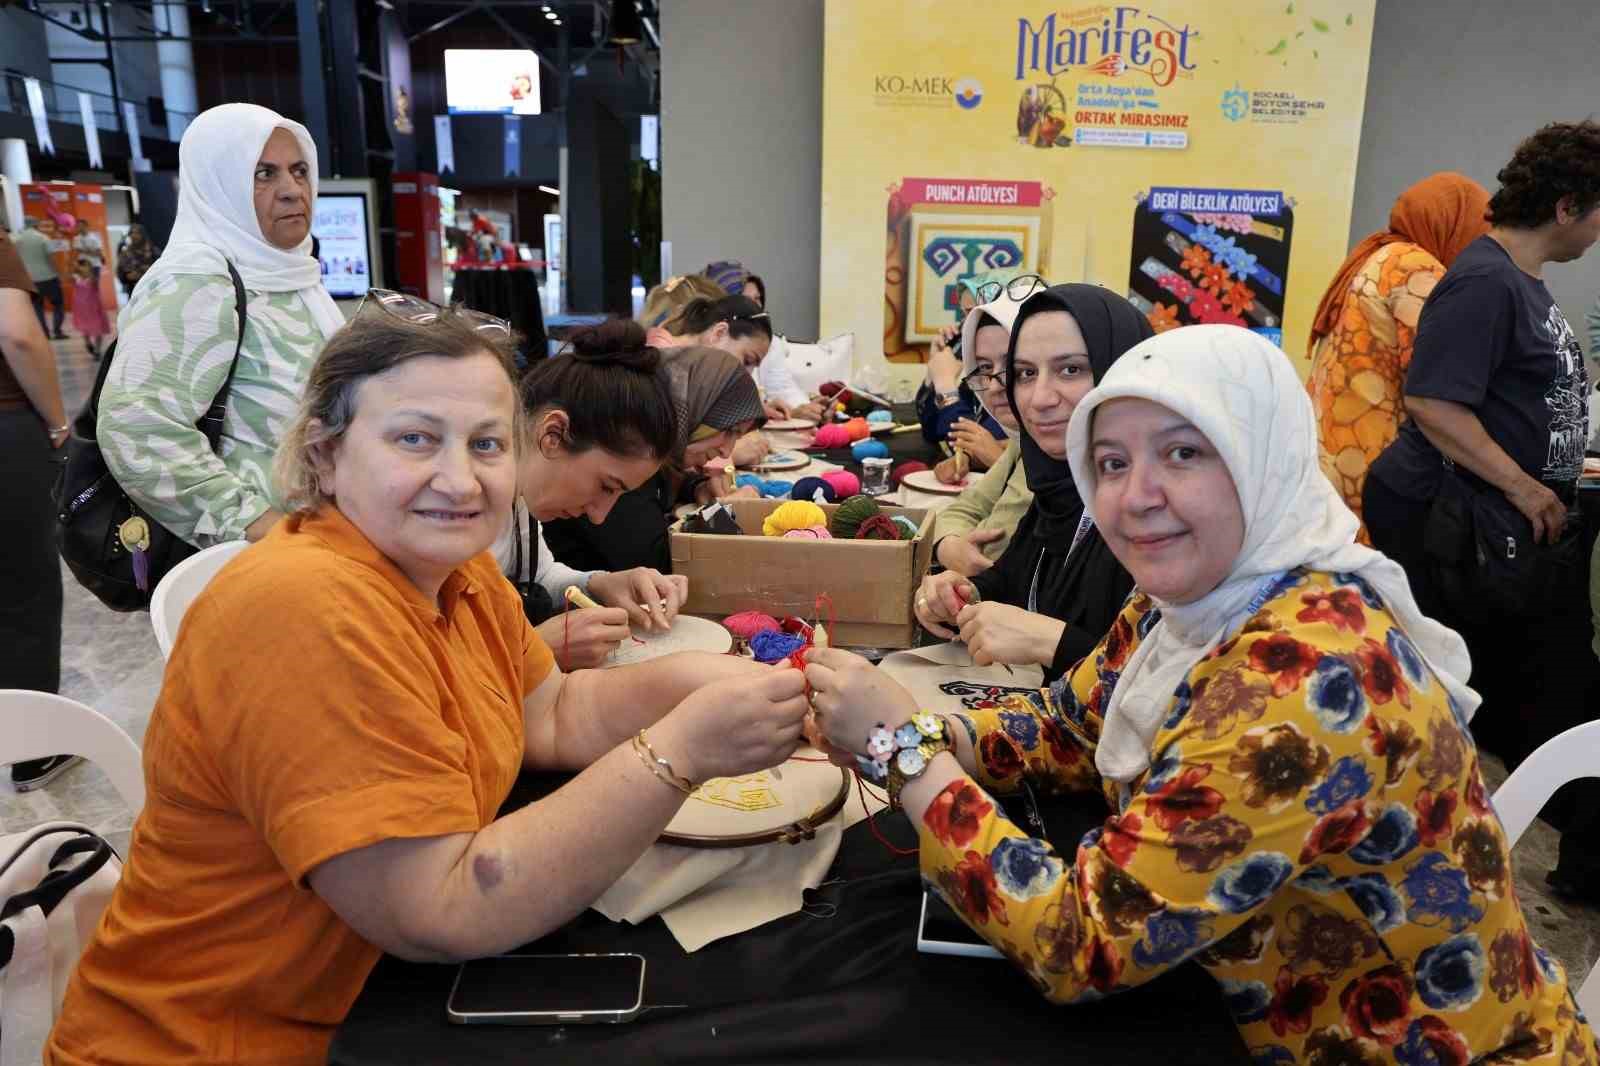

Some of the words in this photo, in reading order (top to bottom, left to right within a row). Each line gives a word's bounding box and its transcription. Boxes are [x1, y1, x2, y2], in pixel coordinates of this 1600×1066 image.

[1016, 7, 1199, 87] MariFest
[874, 75, 953, 95] KO-MEK
[1074, 111, 1117, 125] ORTAK
[925, 183, 966, 202] PUNCH
[967, 183, 1018, 204] ATÖLYESİ
[1152, 190, 1179, 210] DERİ
[1180, 191, 1229, 212] BİLEKLİK
[1229, 193, 1280, 213] ATÖLYESİ
